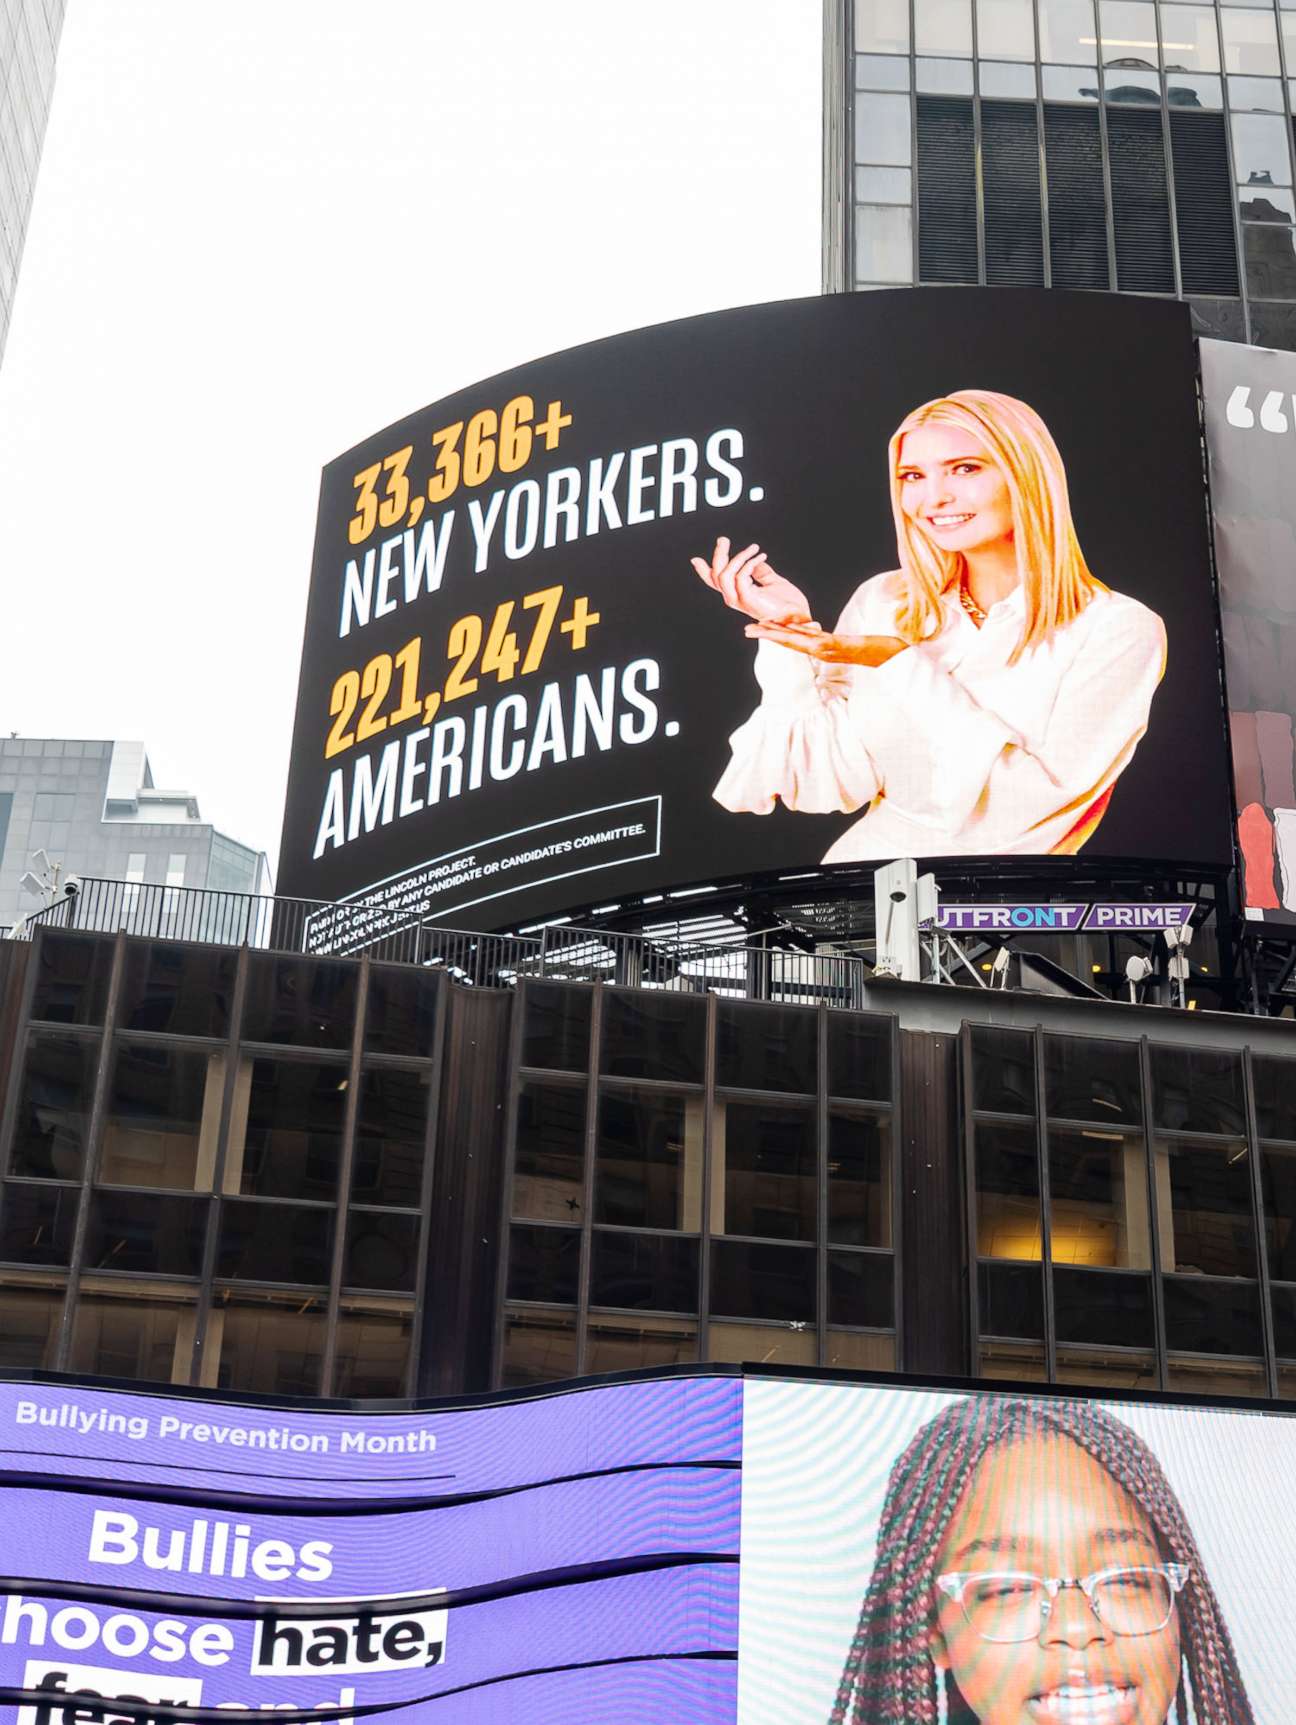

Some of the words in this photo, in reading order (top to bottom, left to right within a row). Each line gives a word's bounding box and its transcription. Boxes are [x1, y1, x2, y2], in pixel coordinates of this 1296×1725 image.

[347, 395, 573, 545] 33,366+
[338, 510, 454, 639] NEW
[468, 428, 766, 573] YORKERS.
[324, 584, 601, 760] 221,247+
[313, 658, 681, 860] AMERICANS.
[364, 891, 384, 909] THE
[385, 873, 427, 899] LINCOLN
[428, 856, 476, 881] PROJECT.
[388, 897, 400, 912] BY
[401, 889, 423, 908] ANY
[424, 869, 482, 895] CANDIDATE
[483, 862, 499, 879] OR
[501, 841, 572, 869] CANDIDATE'S
[573, 823, 646, 849] COMMITTEE.
[935, 907, 1076, 928] UTFRONT
[1097, 907, 1182, 926] PRIME
[15, 1400, 149, 1441] Bullying
[159, 1416, 329, 1454] Prevention
[340, 1430, 437, 1455] Month
[88, 1509, 334, 1582] Bullies
[0, 1595, 234, 1666] hoose
[258, 1604, 443, 1668] hate,
